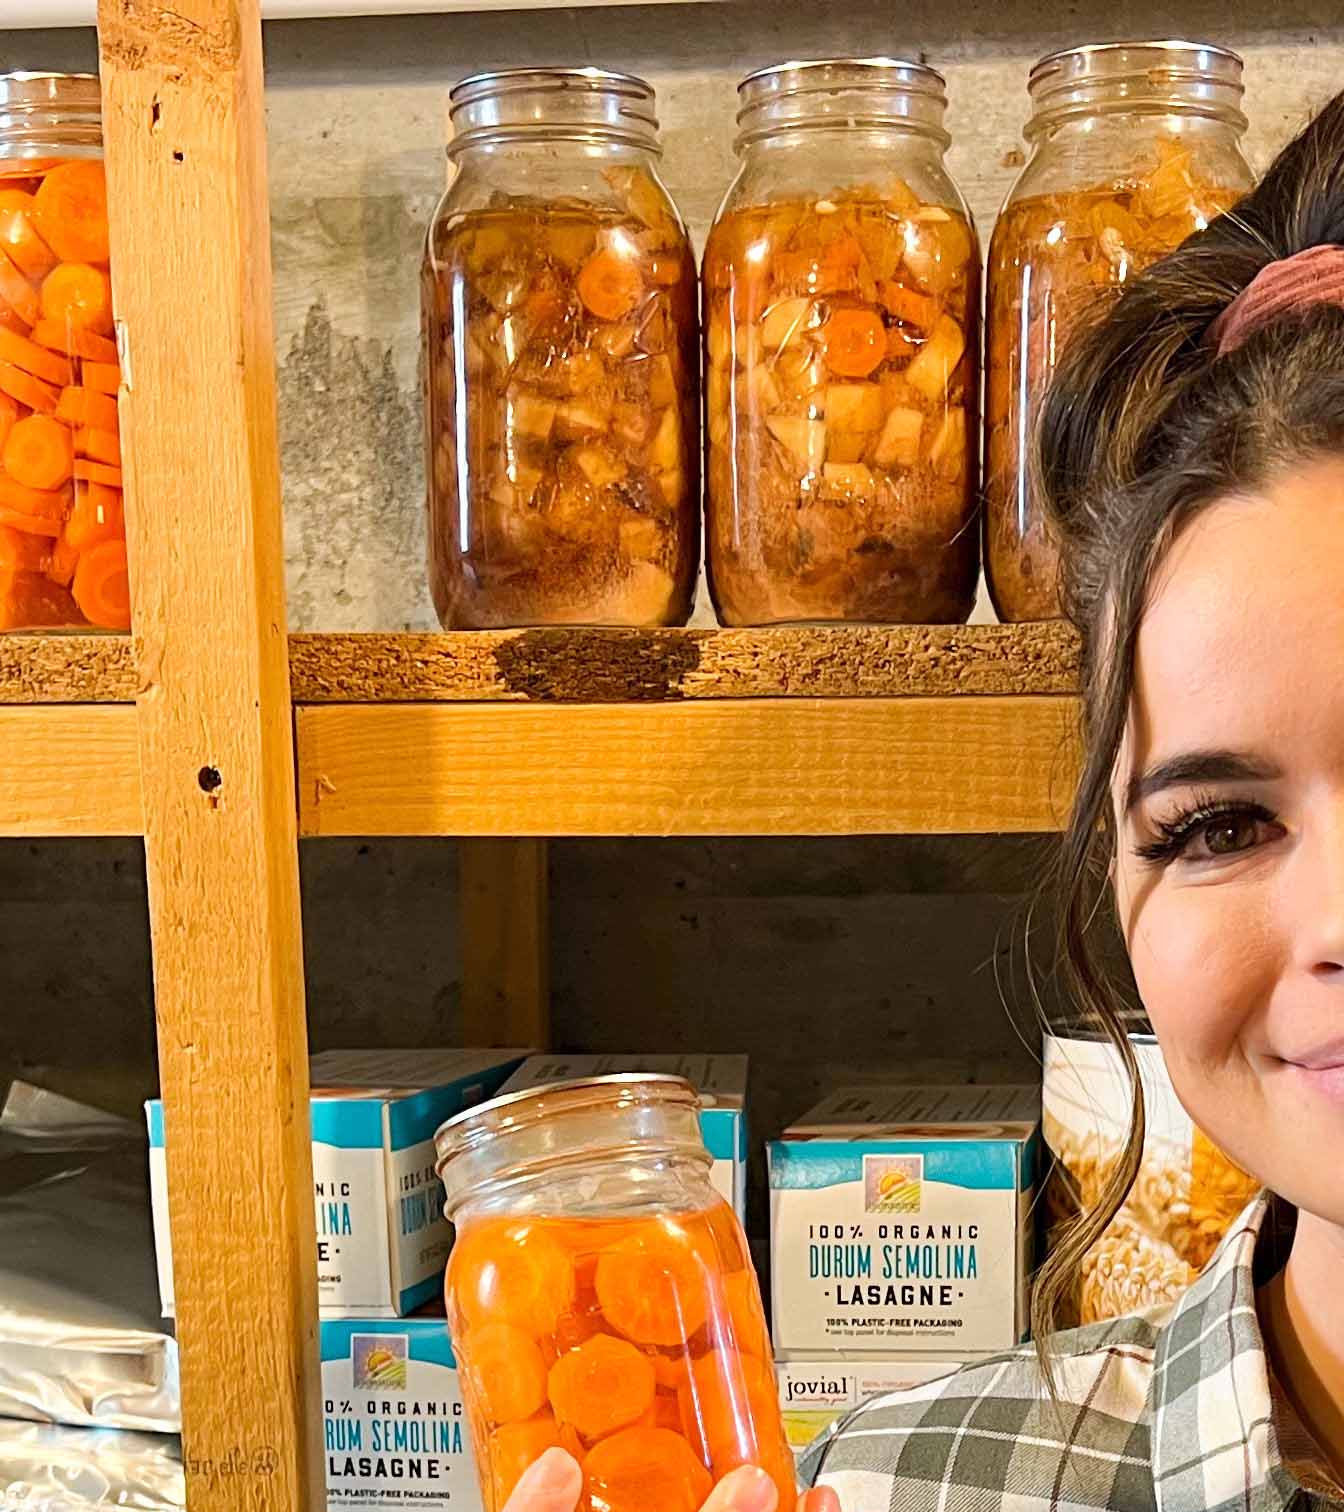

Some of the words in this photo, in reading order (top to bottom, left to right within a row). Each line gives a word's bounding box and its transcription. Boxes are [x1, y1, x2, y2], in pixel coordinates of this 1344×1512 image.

[809, 1224, 863, 1239] 100%
[879, 1224, 979, 1239] ORGANIC
[809, 1245, 871, 1279] DURUM
[882, 1244, 978, 1279] SEMOLINA
[836, 1285, 954, 1305] LASAGNE
[826, 1318, 848, 1327] 100%
[851, 1318, 911, 1328] PLASTIC-FREE
[913, 1319, 963, 1328] PACKAGING
[786, 1376, 849, 1401] jovial
[325, 1400, 353, 1413] 0%
[367, 1401, 462, 1416] ORGANIC
[325, 1418, 362, 1452] RUM
[372, 1419, 463, 1454] SEMOLINA
[329, 1456, 440, 1479] LASAGNE
